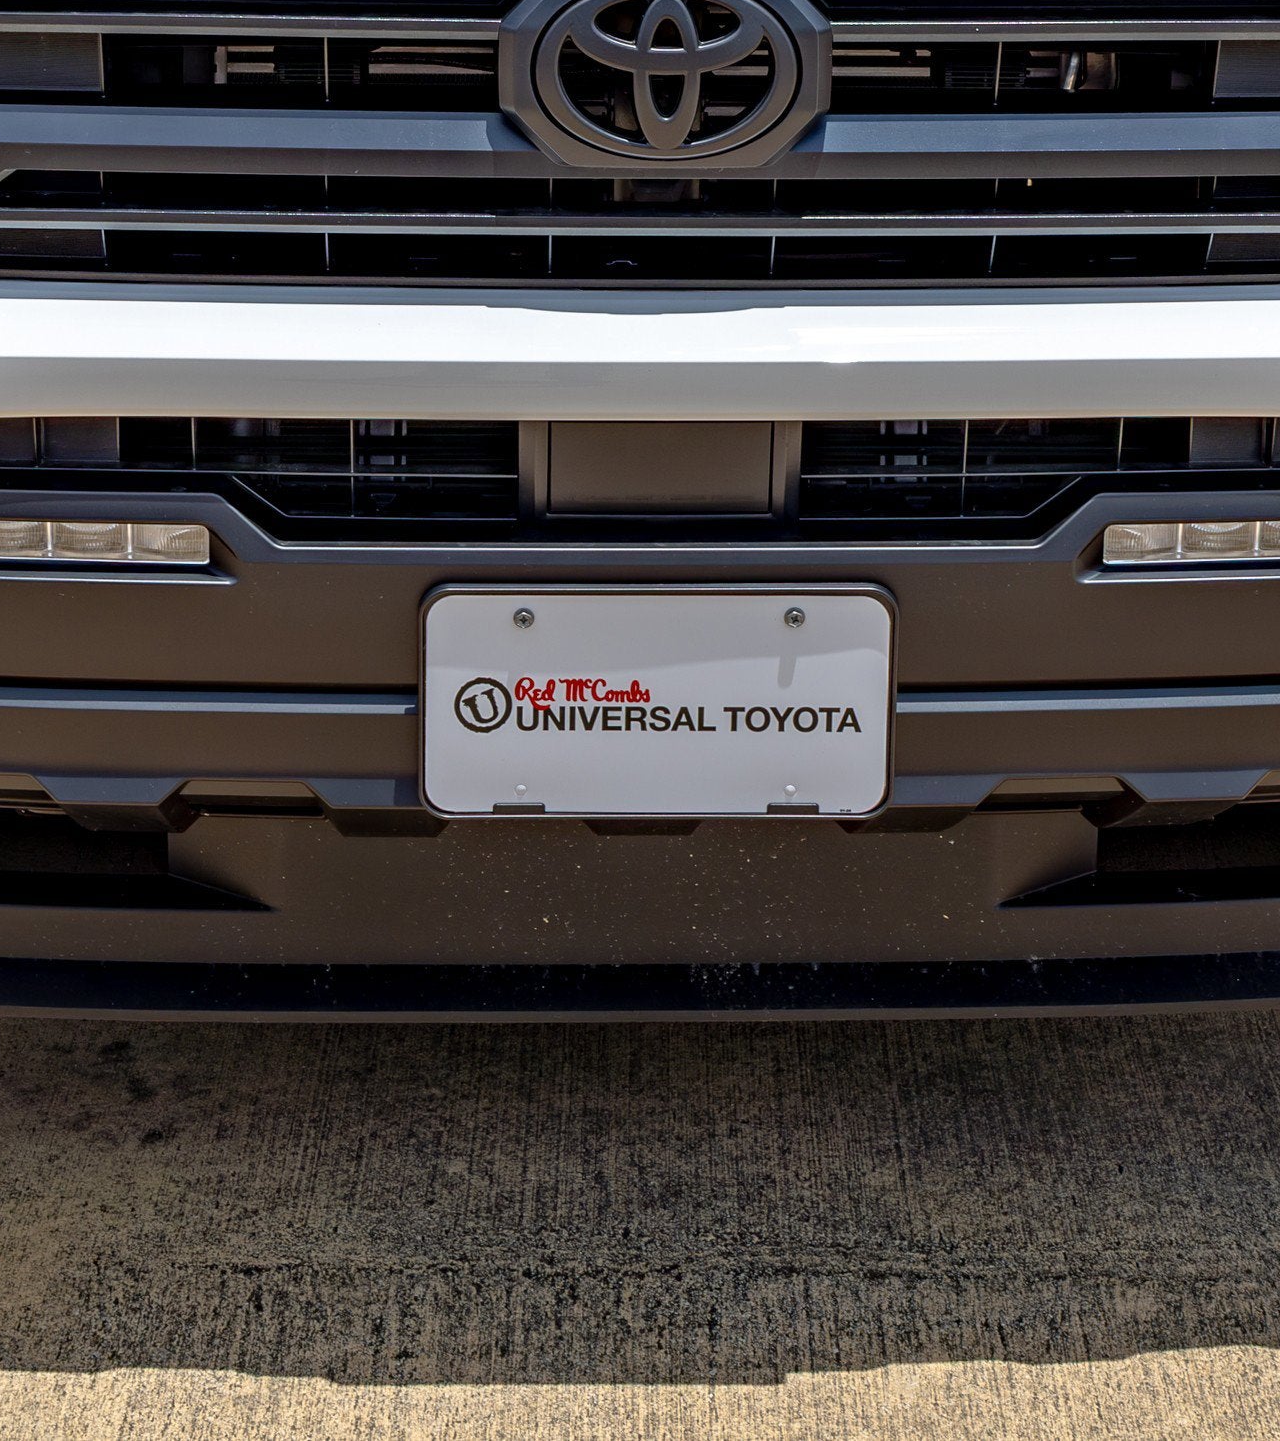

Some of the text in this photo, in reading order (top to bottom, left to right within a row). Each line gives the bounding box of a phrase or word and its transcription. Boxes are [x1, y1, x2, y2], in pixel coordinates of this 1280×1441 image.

[515, 677, 651, 711] Red McCombs
[516, 705, 863, 734] UNIVERSAL TOYOTA
